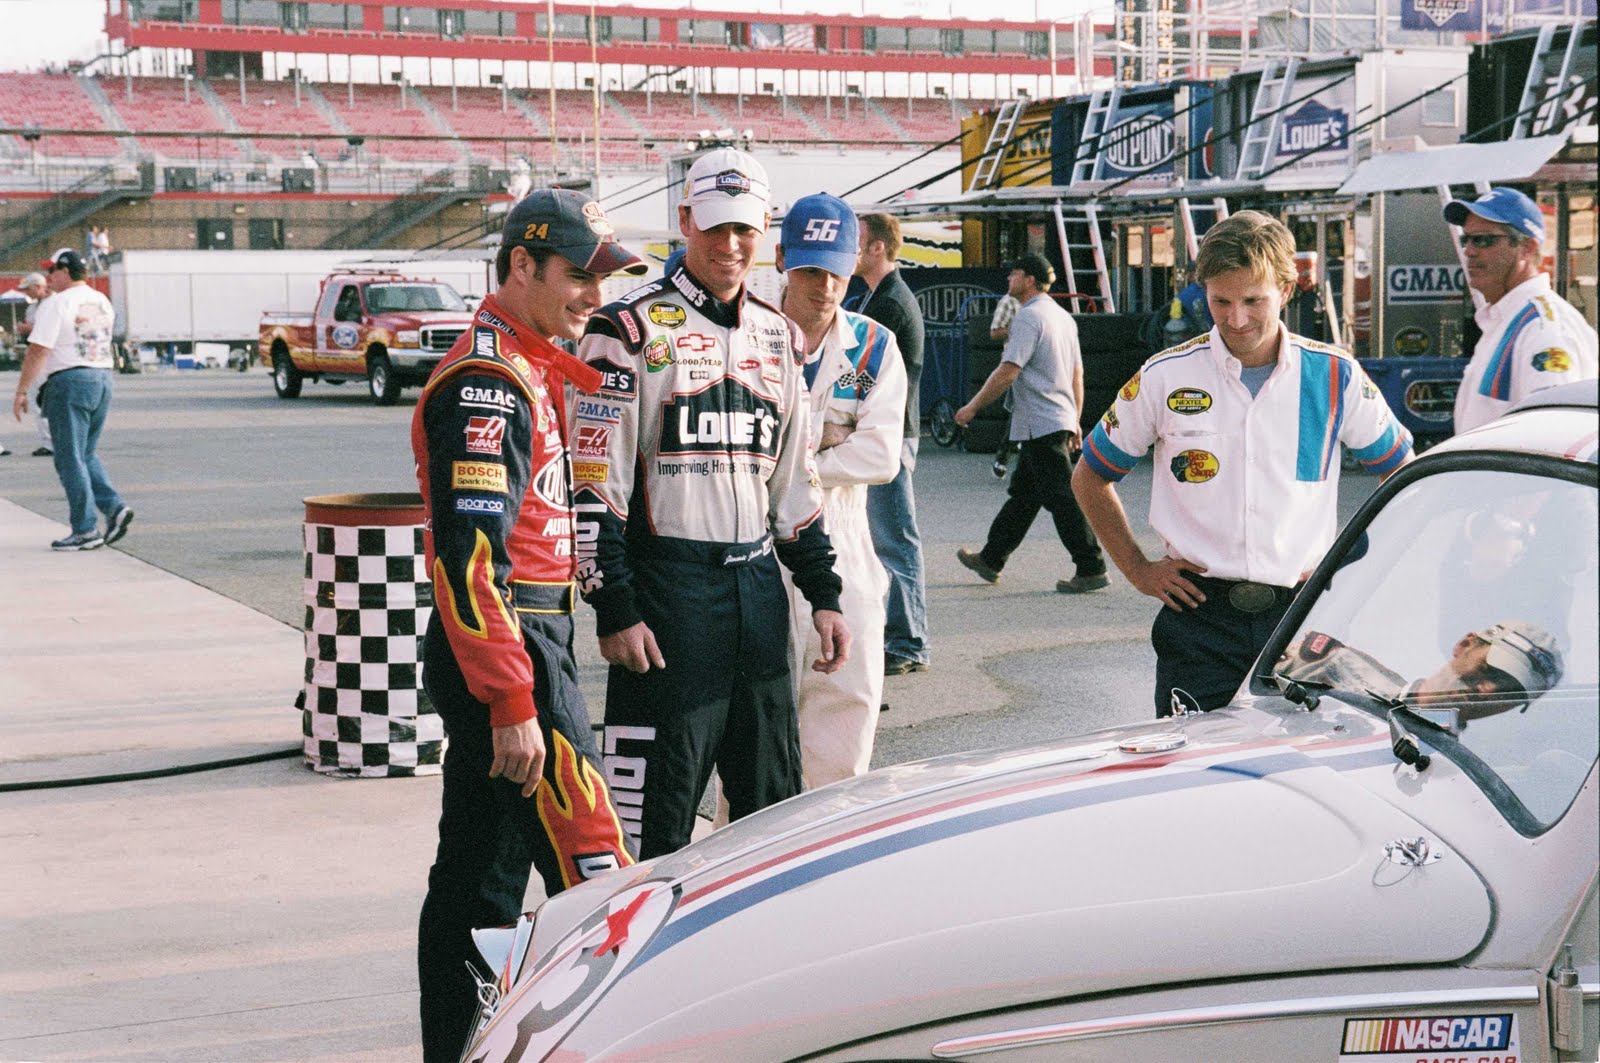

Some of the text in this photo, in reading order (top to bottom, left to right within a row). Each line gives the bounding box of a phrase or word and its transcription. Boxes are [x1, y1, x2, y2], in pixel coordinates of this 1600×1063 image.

[1281, 117, 1342, 151] LOWE'S
[524, 223, 549, 240] 24
[803, 218, 841, 242] 56
[671, 267, 708, 307] LOWE'S
[620, 311, 640, 341] SIMPSON
[461, 386, 516, 408] GMAC
[577, 401, 620, 418] GMAC
[680, 406, 775, 449] LOWE'S
[473, 439, 498, 449] HAAS
[581, 446, 603, 455] HAAS
[457, 466, 502, 478] BOSCH
[658, 460, 709, 477] Improving
[457, 477, 480, 486] Spark
[1395, 1017, 1502, 1050] NASCAR
